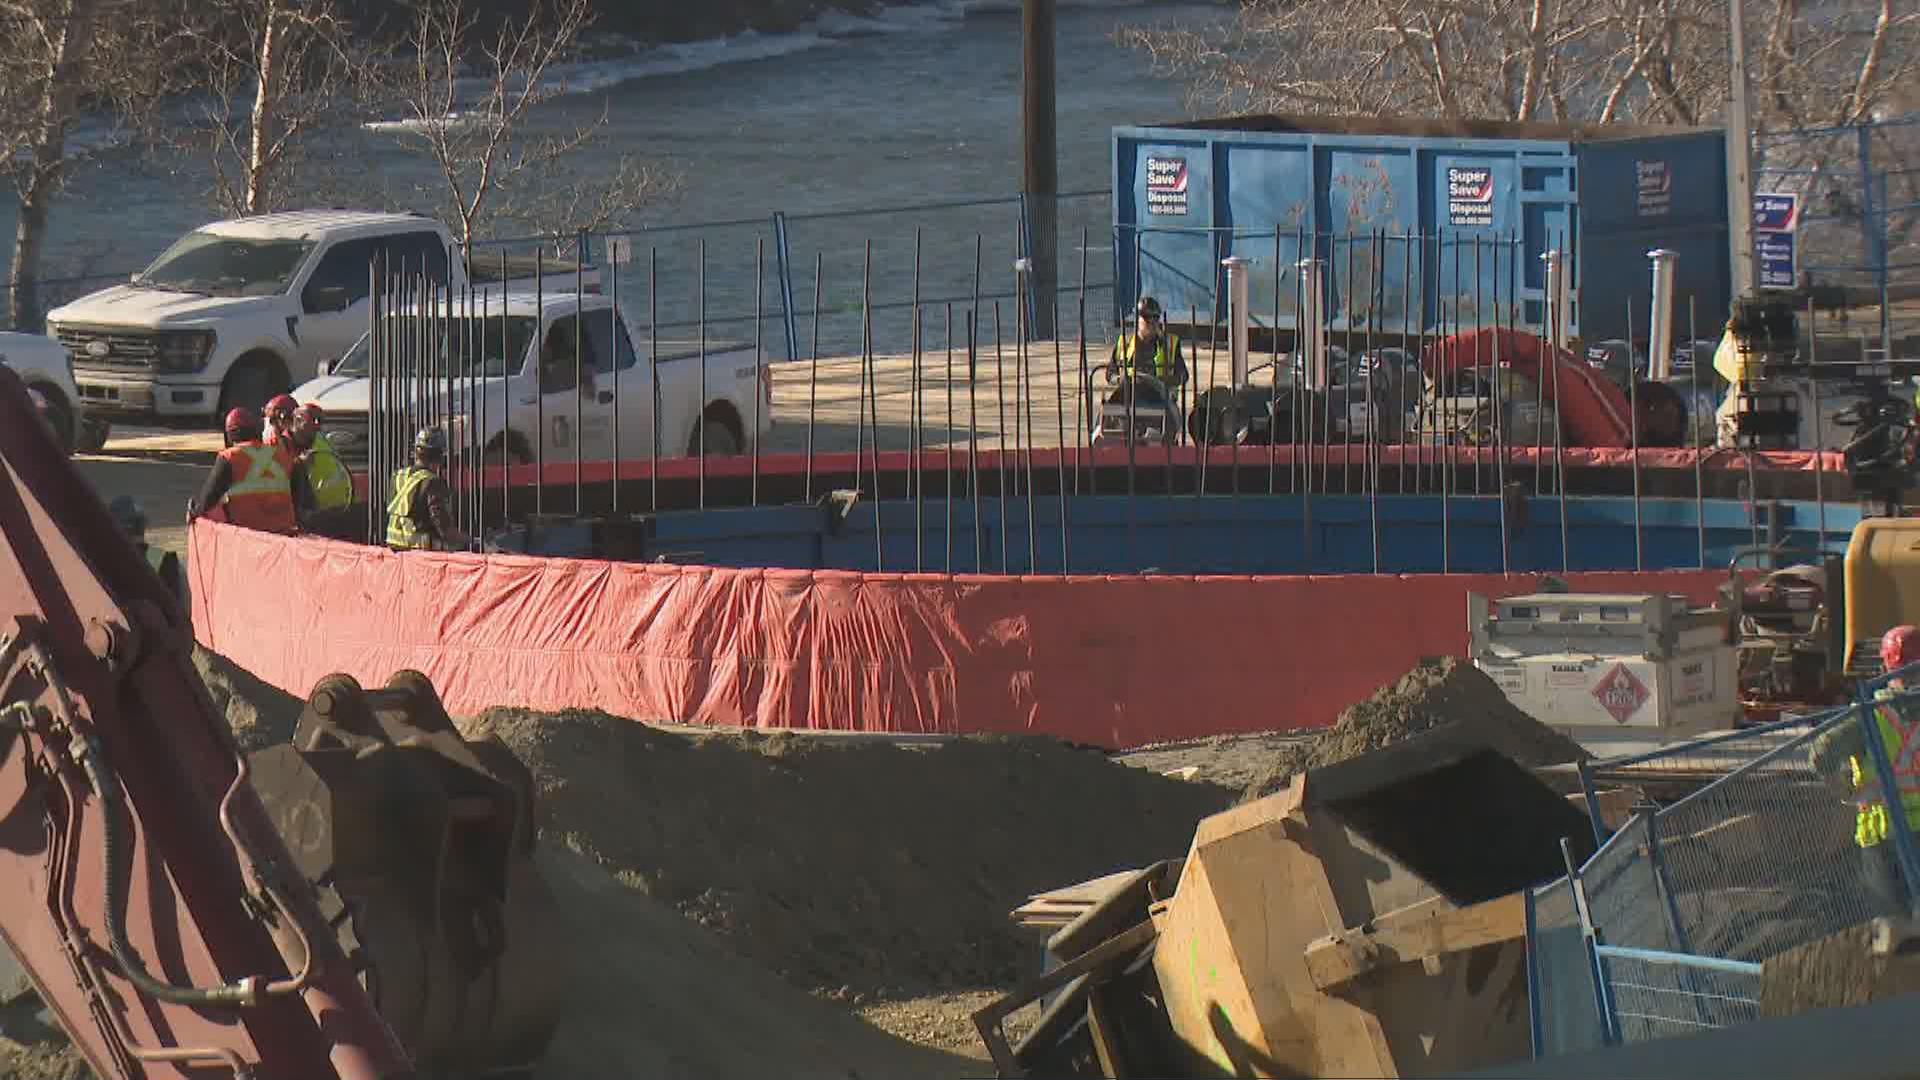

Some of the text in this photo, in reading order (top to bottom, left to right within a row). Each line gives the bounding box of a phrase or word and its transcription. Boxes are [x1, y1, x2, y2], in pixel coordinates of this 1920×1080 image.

[1147, 159, 1183, 174] Super
[1147, 172, 1176, 184] Save
[1449, 169, 1488, 184] Super
[1449, 183, 1481, 196] Save
[1148, 192, 1187, 204] Disposal
[1450, 203, 1492, 215] Disposal
